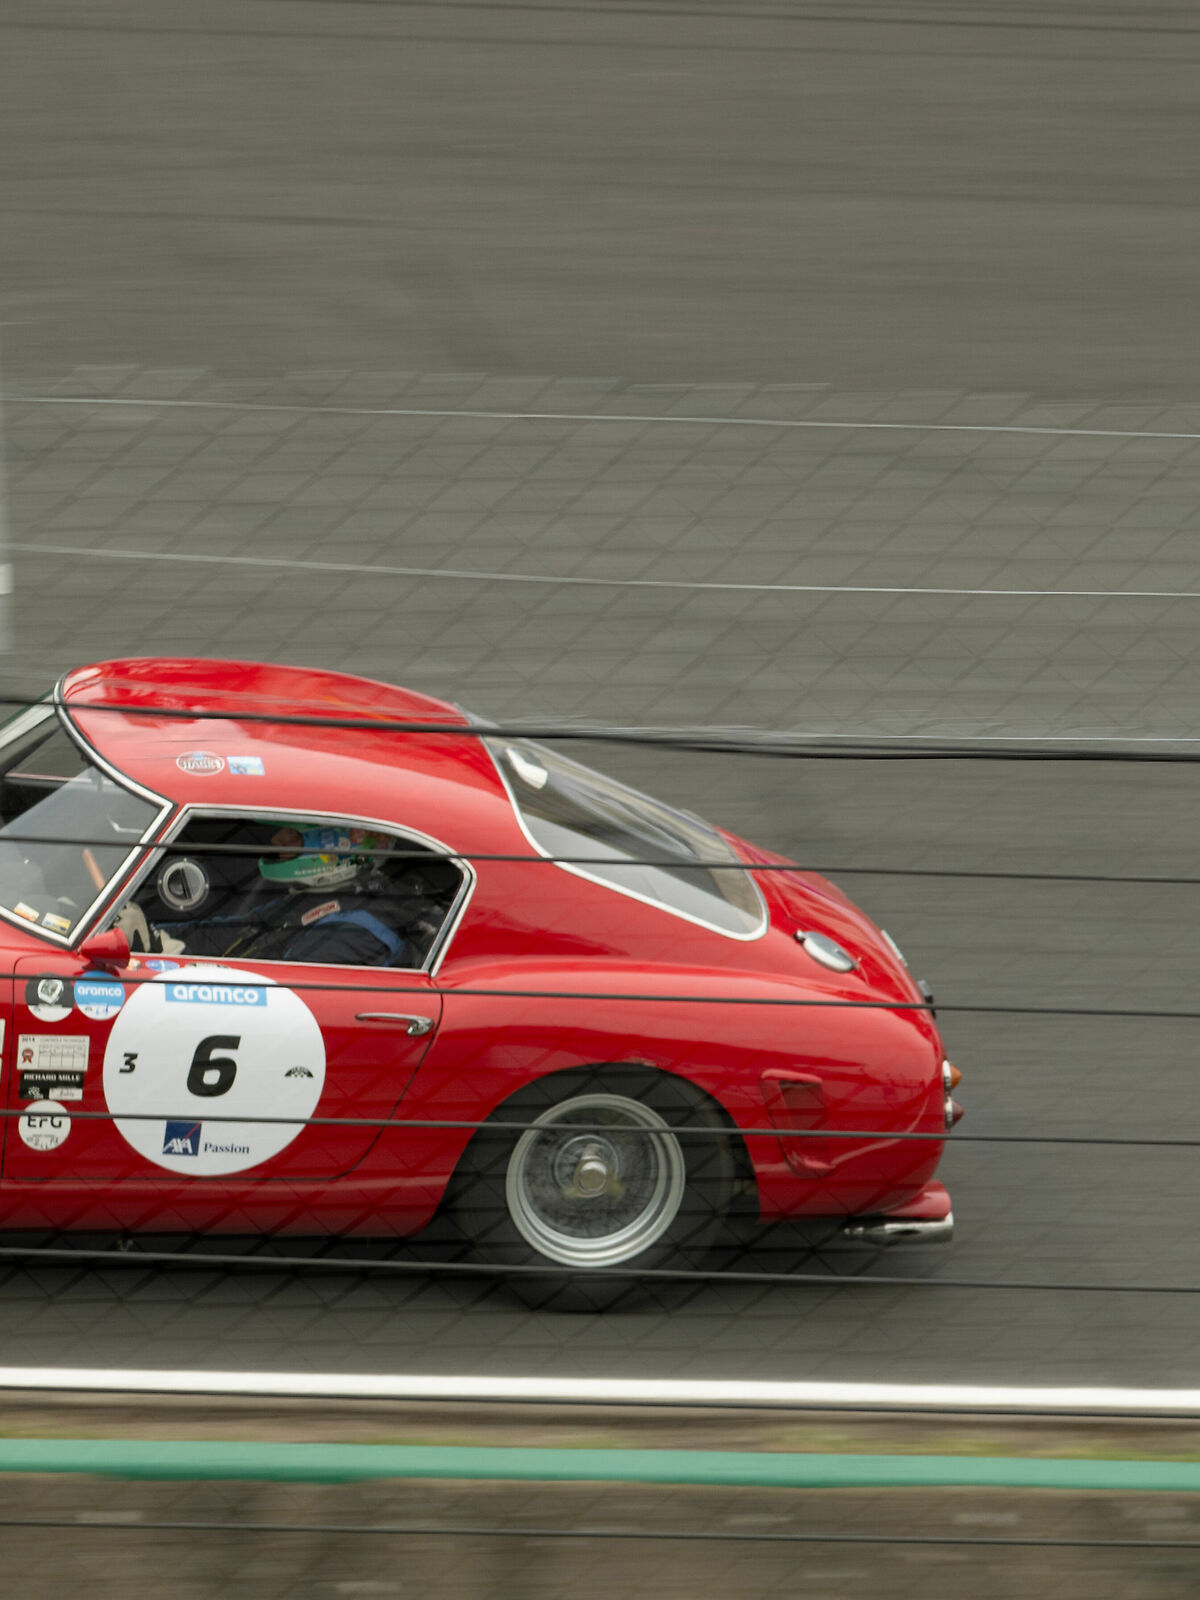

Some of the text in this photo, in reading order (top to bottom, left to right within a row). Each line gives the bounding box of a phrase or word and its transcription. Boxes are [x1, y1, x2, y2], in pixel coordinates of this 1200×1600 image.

[77, 985, 122, 997] aramco
[173, 984, 259, 1004] aramco
[119, 1052, 138, 1073] 3
[187, 1034, 241, 1098] 6
[23, 1073, 80, 1082] RICHARD MILLE
[27, 1113, 62, 1128] EFG
[162, 1137, 193, 1154] AXA
[204, 1142, 250, 1155] Passion
